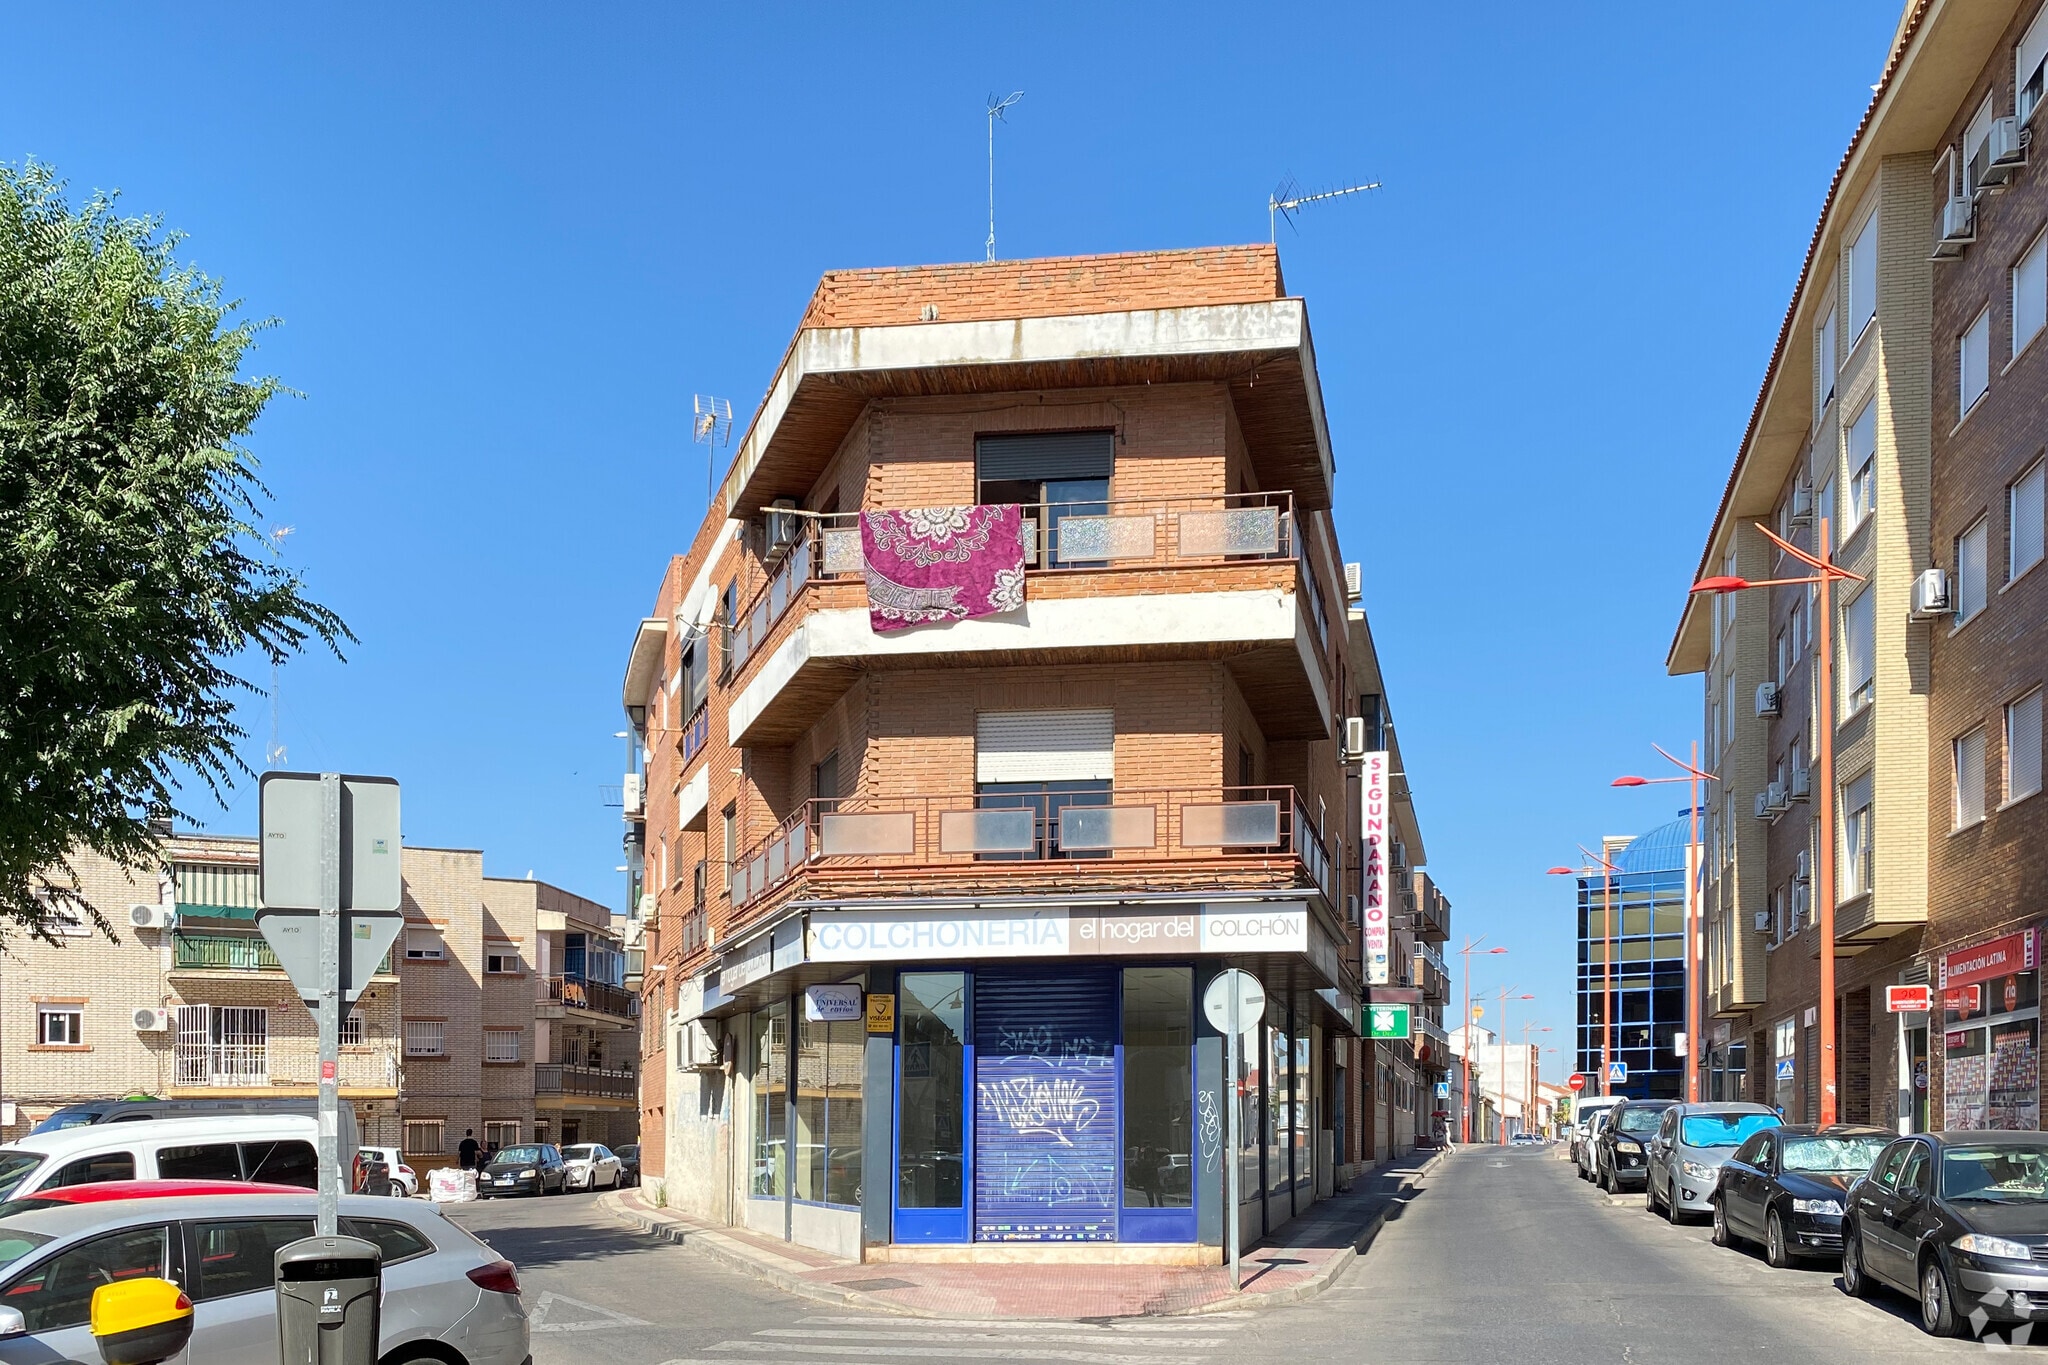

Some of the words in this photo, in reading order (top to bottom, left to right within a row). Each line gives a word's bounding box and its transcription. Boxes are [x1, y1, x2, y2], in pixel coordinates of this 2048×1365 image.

[1367, 757, 1384, 922] SEGUNDAMANO
[818, 910, 1063, 950] COLCHONERÍA
[1079, 918, 1096, 939] el
[1101, 918, 1161, 943] hogar
[1163, 915, 1194, 938] del
[1209, 915, 1299, 937] COLCHÓN
[1367, 939, 1384, 950] VENTA
[1948, 954, 1986, 977] ALIMENTACIÓN
[1986, 950, 2007, 967] LATINA
